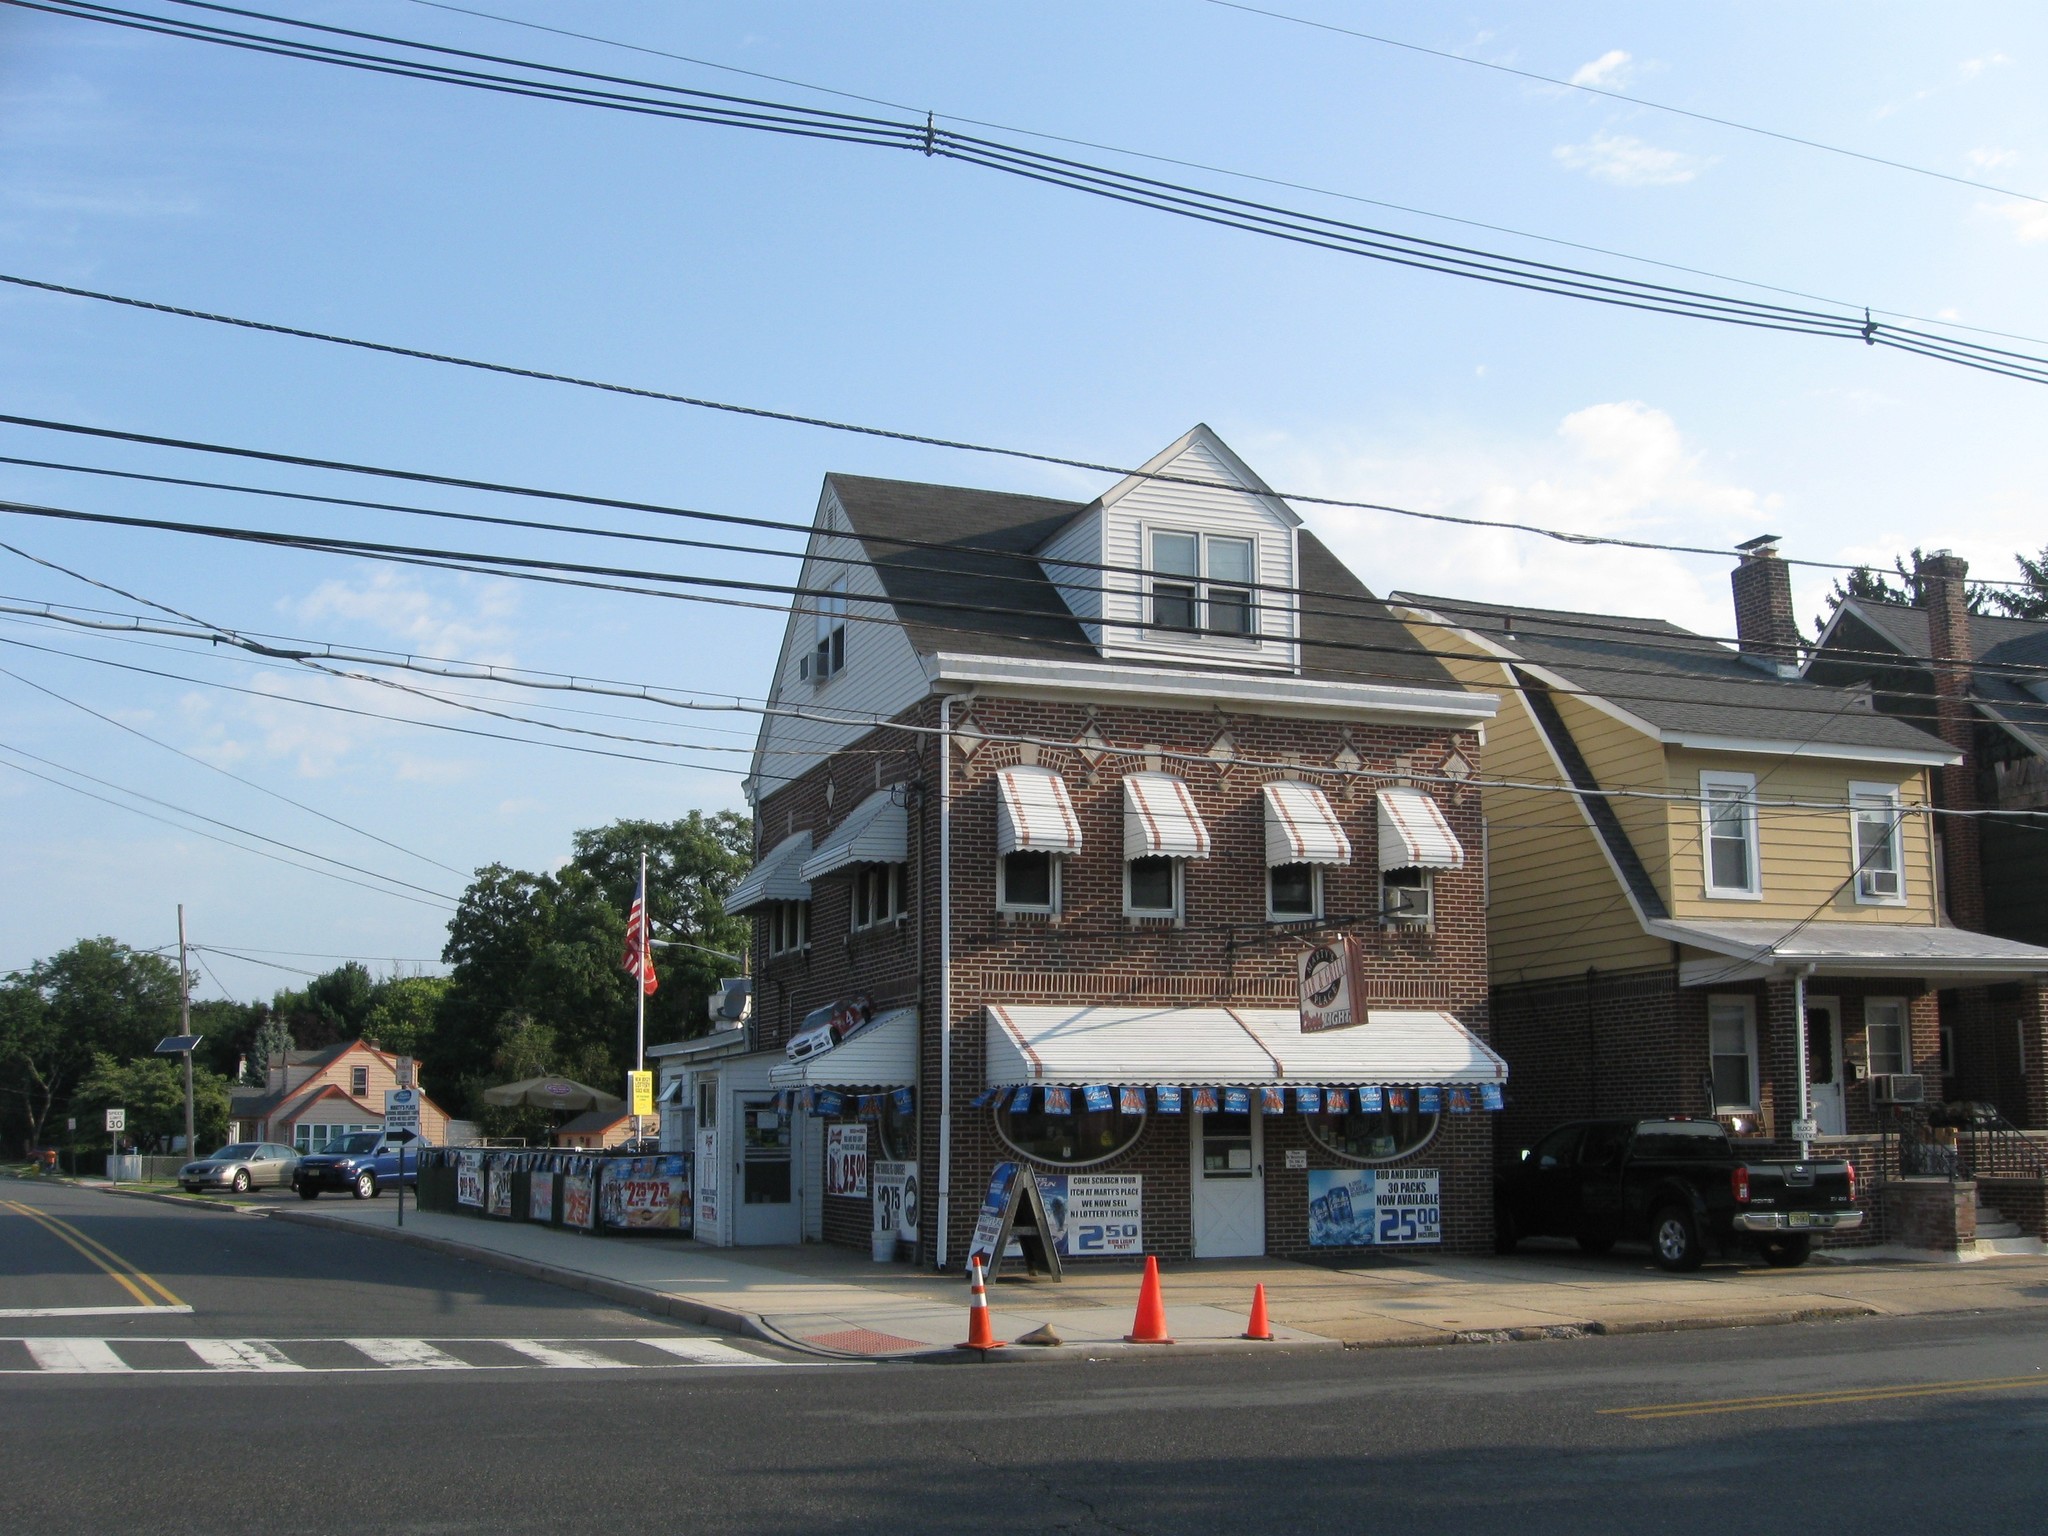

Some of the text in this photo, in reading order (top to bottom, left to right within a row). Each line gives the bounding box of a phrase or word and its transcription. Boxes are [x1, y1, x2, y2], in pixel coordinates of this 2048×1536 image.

[1306, 949, 1335, 973] MARTY'S
[1314, 984, 1338, 1006] PLACE
[846, 1010, 854, 1025] 4
[1324, 1009, 1351, 1027] LIGHT
[109, 1120, 123, 1128] 30
[1376, 1169, 1437, 1179] BUD AND BUD LIGHT
[1388, 1182, 1426, 1193] 30 PACKS
[1377, 1194, 1438, 1206] NOW AVAILABLE
[1080, 1210, 1108, 1218] LOTTERY
